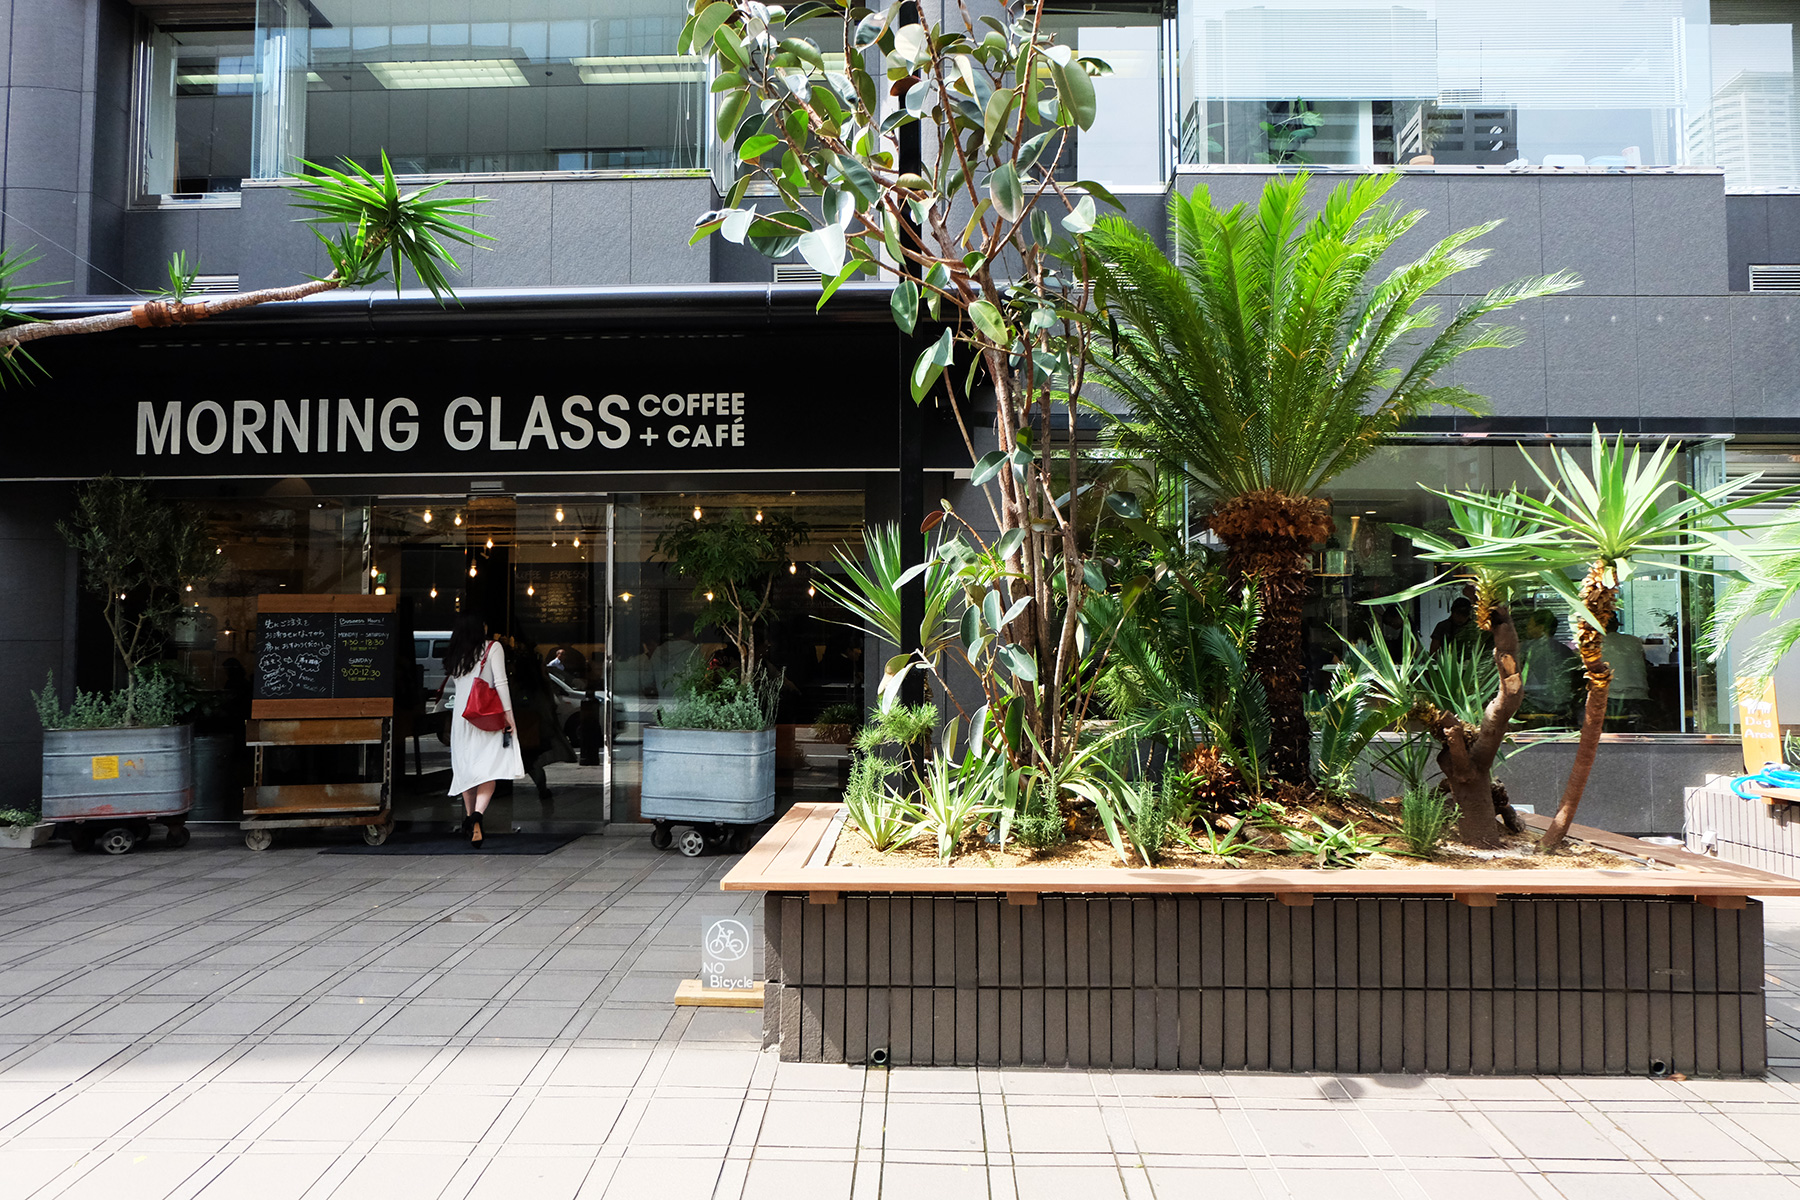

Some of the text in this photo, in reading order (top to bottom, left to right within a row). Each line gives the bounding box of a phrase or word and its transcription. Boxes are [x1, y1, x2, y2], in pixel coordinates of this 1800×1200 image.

[637, 393, 745, 417] COFFEE
[136, 394, 631, 455] MORNING GLASS
[639, 416, 745, 448] + CAFÉ
[339, 617, 365, 626] Business
[348, 657, 373, 665] SUNDAY
[1744, 716, 1772, 728] Dog
[1744, 728, 1775, 739] Area
[703, 962, 725, 974] NO
[710, 974, 753, 991] Bicycle
